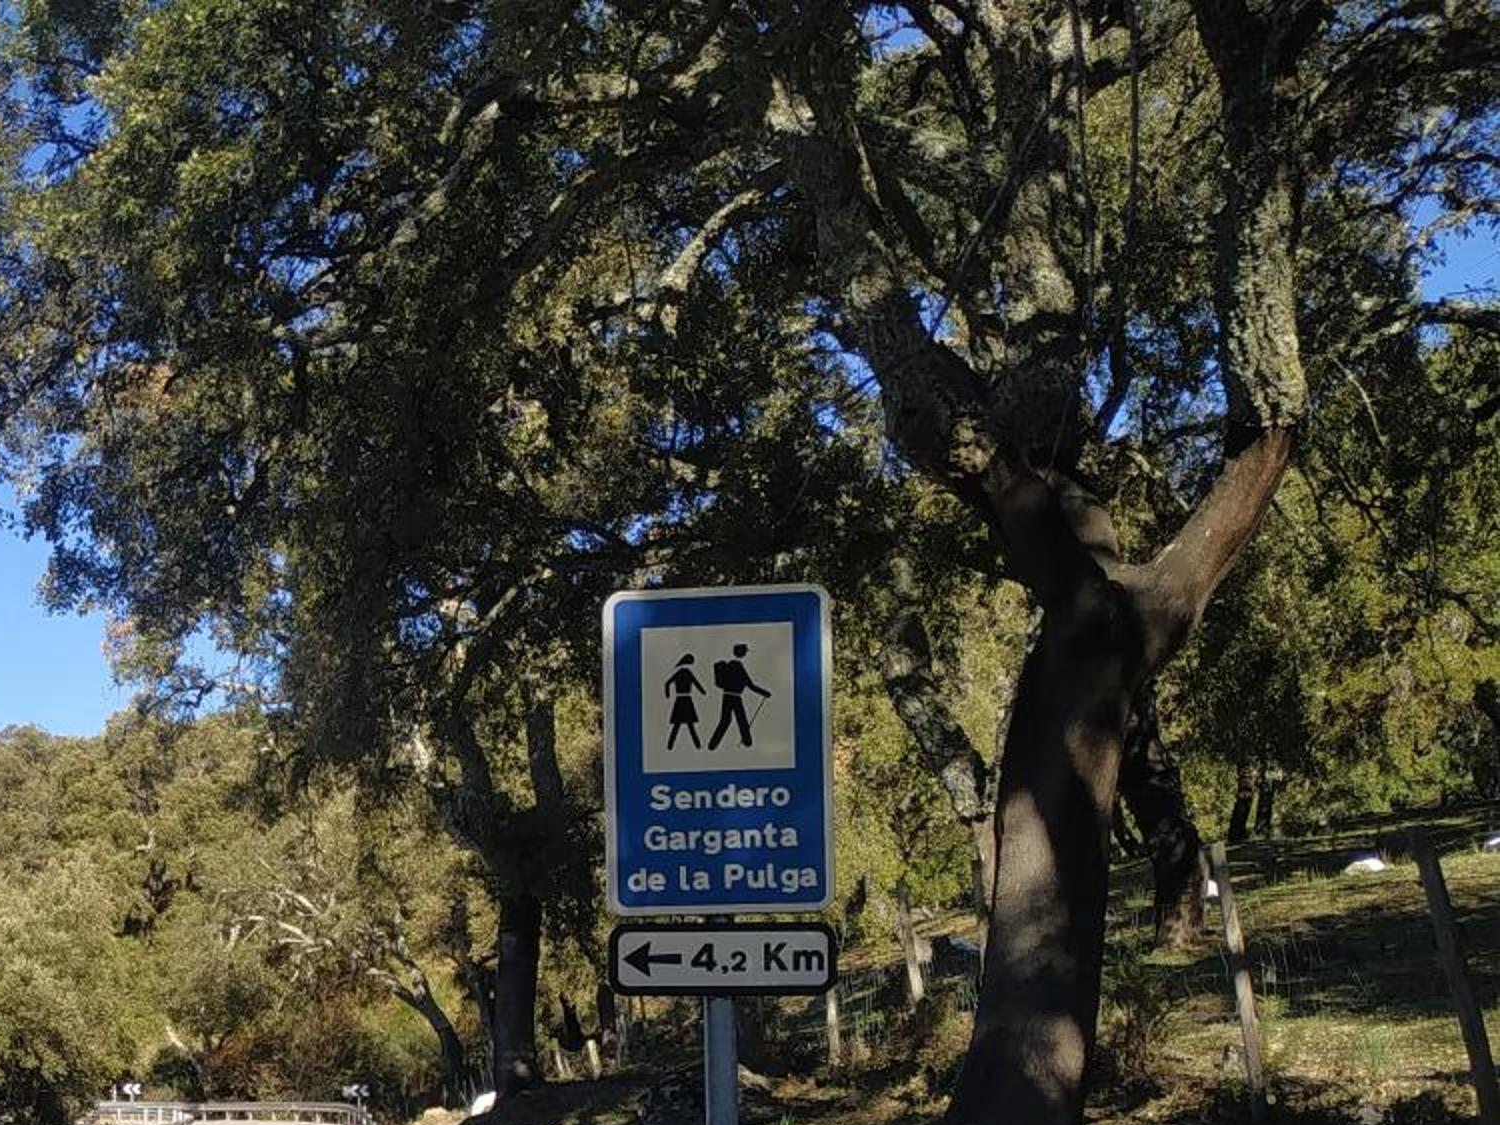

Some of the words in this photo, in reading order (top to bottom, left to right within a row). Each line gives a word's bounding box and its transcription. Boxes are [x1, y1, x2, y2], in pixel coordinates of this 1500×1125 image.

[650, 784, 790, 811] Sendero
[644, 822, 799, 854] Garganta
[627, 868, 666, 892] de
[679, 865, 711, 891] la
[724, 864, 818, 893] Pulga
[691, 943, 747, 974] 4,2
[763, 942, 823, 971] Km
